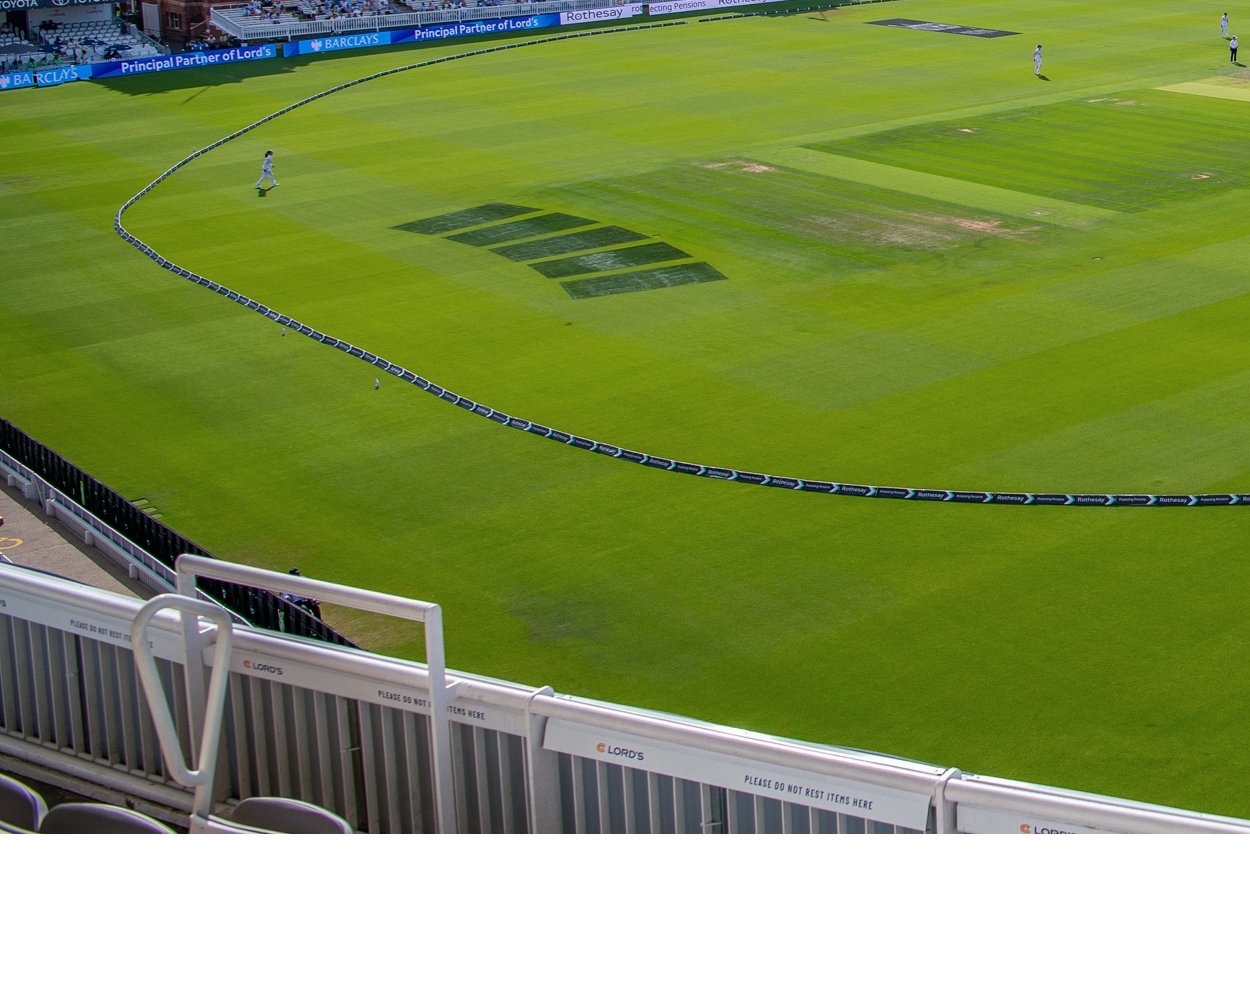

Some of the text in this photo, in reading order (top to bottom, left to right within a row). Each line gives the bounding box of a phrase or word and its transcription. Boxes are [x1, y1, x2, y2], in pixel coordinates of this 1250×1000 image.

[674, 0, 706, 10] Pensions
[567, 8, 623, 21] Rothesay
[415, 18, 538, 39] Principal Partner of Lord's
[325, 34, 378, 49] BARCLAYS
[121, 47, 271, 73] Principal Partner of Lord's
[70, 619, 88, 631] PLEASE
[98, 627, 108, 635] NOT
[378, 690, 401, 702] PLEASE
[403, 696, 411, 704] DO
[414, 699, 426, 707] NOT
[447, 705, 485, 720] ITEMS HERE
[608, 746, 644, 760] LORD'S
[744, 775, 873, 810] PLEASE DO NOT REST ITEMS HERE
